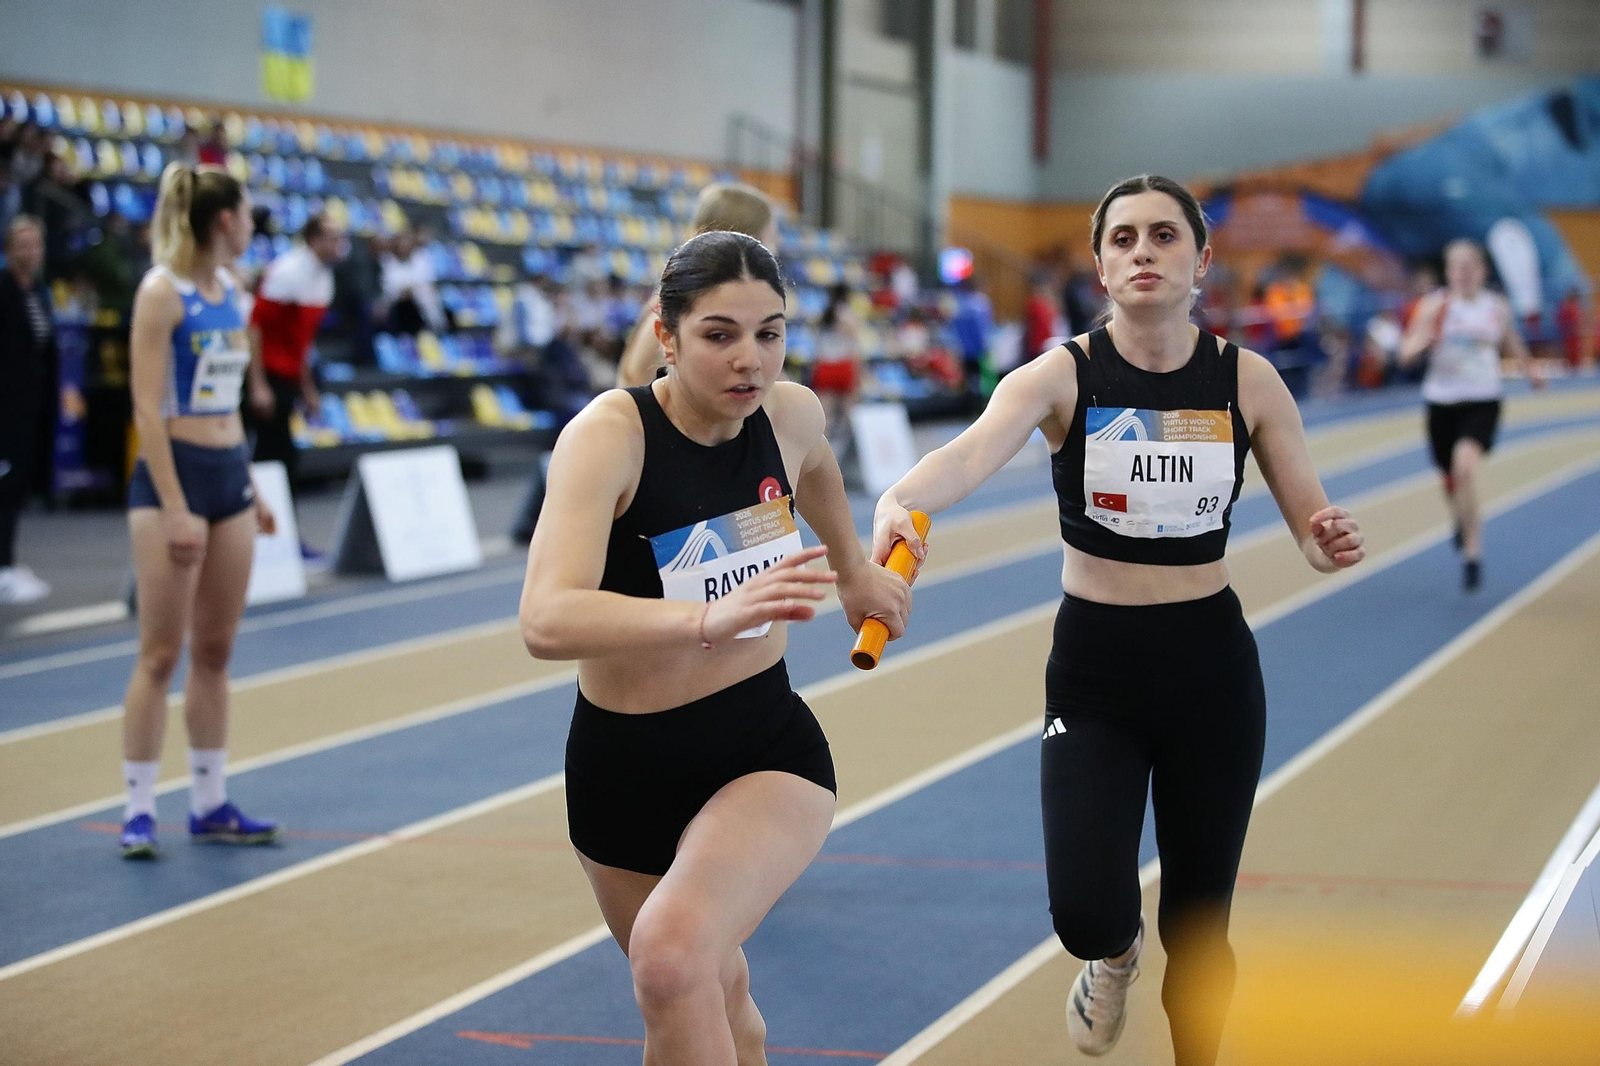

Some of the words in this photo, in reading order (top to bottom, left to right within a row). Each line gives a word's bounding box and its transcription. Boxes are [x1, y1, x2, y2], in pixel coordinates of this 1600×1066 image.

[1189, 418, 1216, 426] WORLD
[1130, 454, 1193, 483] ALTIN
[734, 510, 752, 521] 2026
[1195, 496, 1219, 516] 93
[737, 516, 762, 529] VIRTUS
[761, 509, 782, 522] WORLD
[740, 525, 763, 539] SHORT
[763, 519, 781, 531] TRACK
[742, 526, 786, 547] CHAMPIONSHIP
[704, 554, 784, 603] BAY
